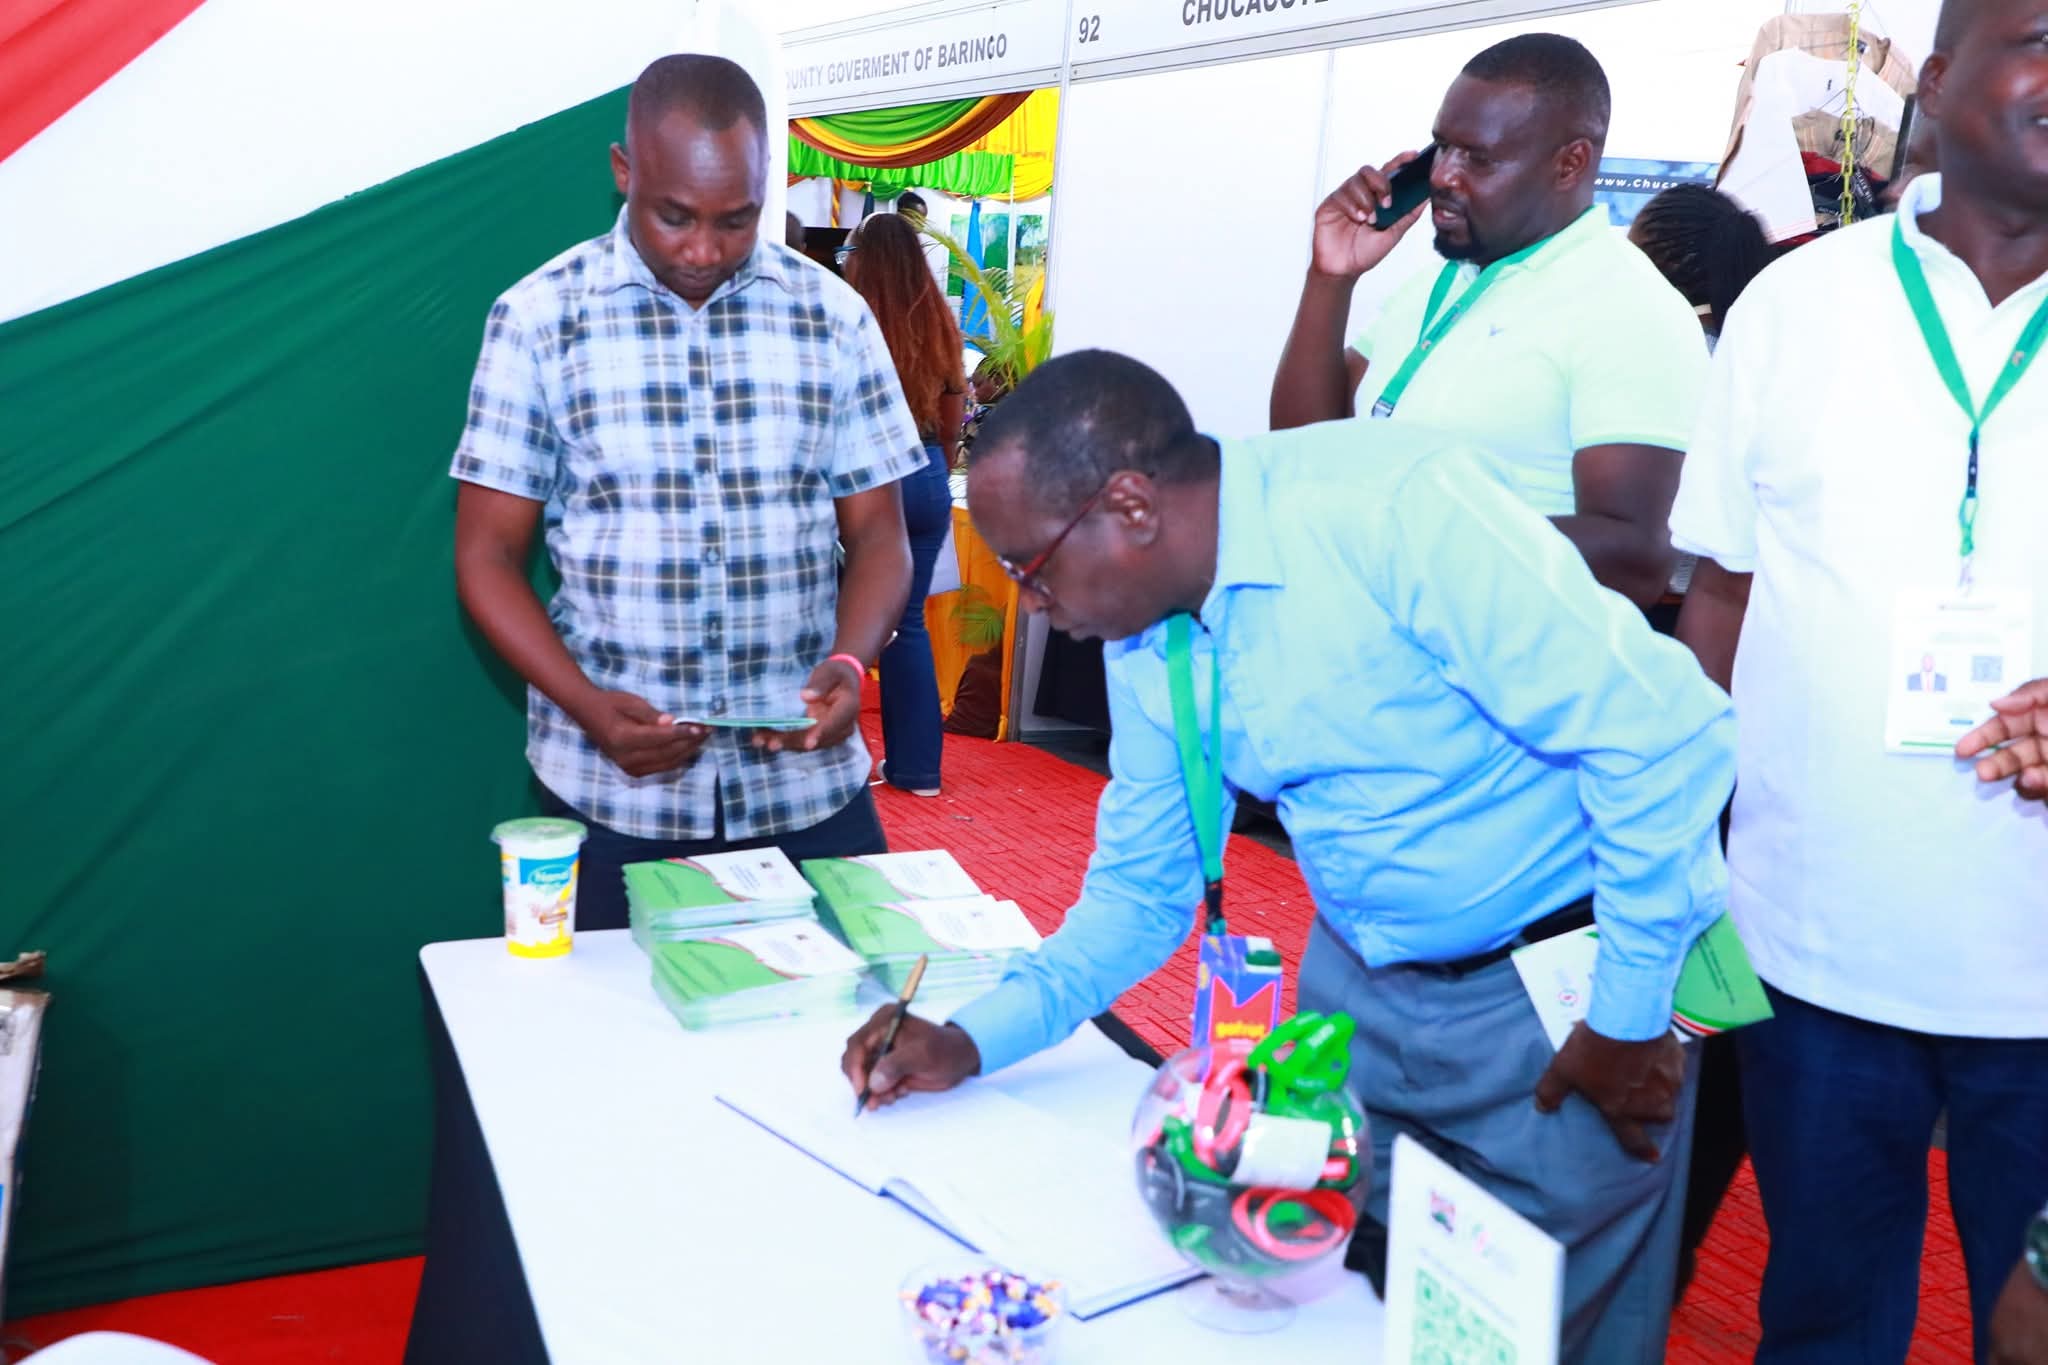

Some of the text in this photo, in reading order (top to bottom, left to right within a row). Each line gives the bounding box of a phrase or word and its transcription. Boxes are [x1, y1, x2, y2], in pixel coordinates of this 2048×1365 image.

[1182, 0, 1328, 26] CHUCA
[1078, 15, 1100, 43] 92
[827, 50, 909, 84] GOVERMENT
[914, 46, 932, 71] OF
[938, 33, 1007, 68] BARINGO
